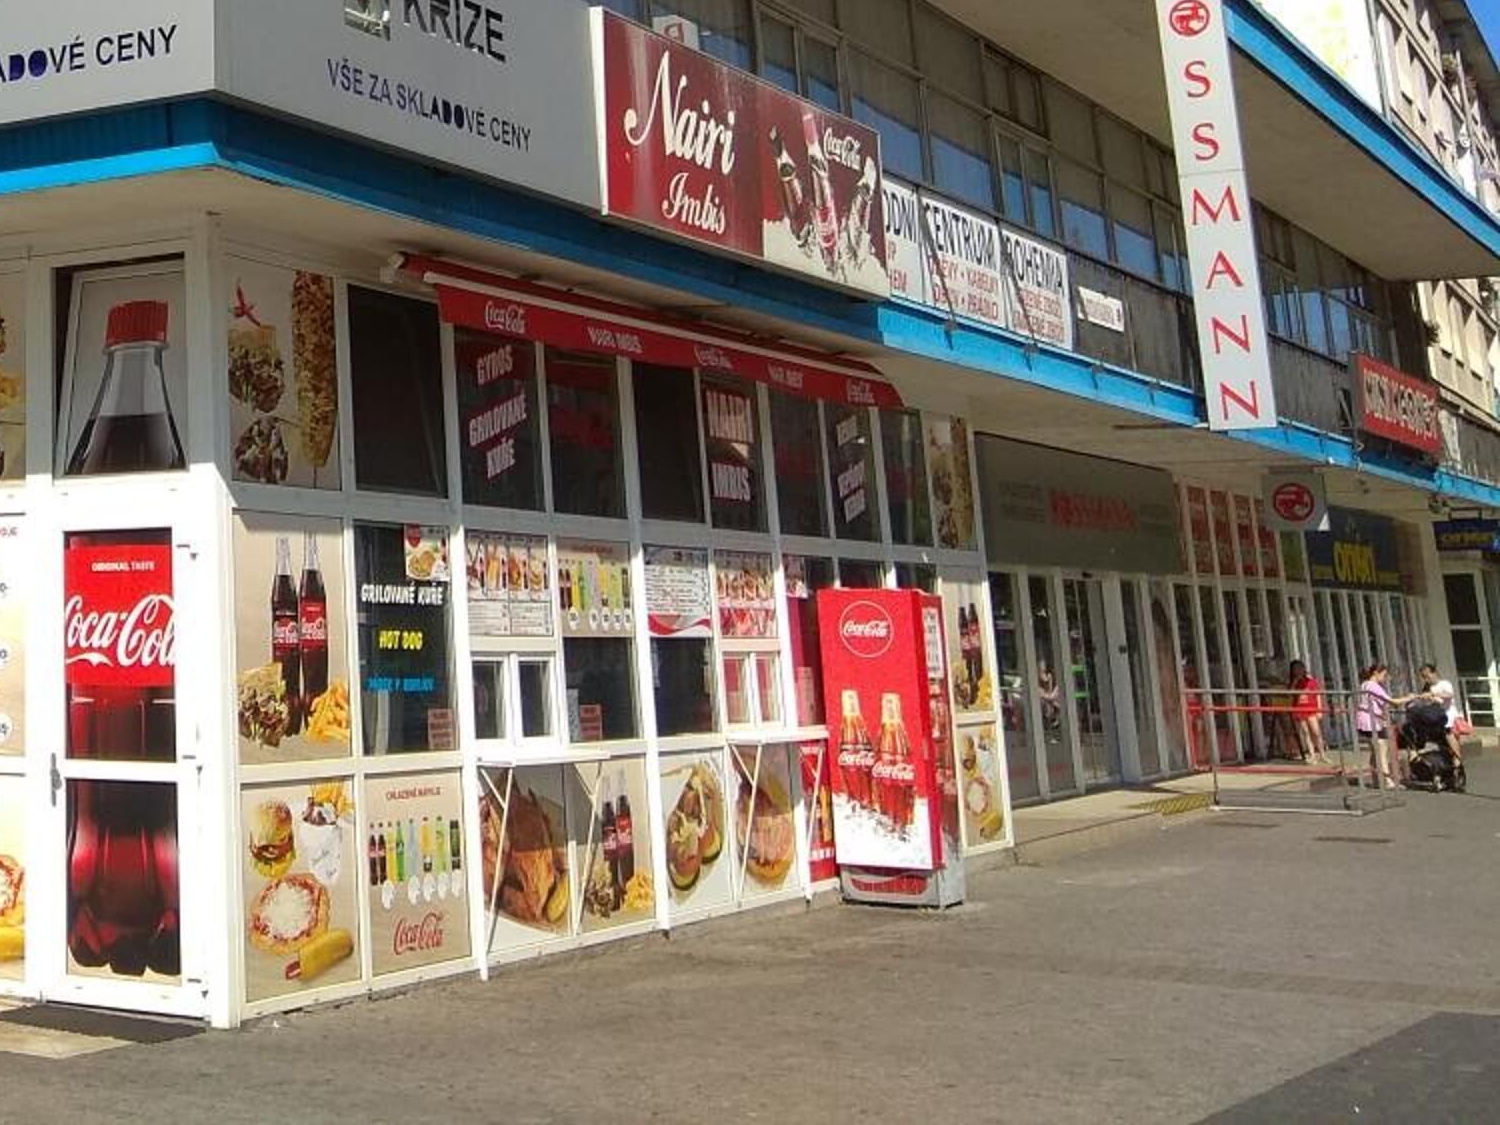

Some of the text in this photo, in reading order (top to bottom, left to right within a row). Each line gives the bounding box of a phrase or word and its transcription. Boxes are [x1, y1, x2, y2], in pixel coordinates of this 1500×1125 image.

[95, 23, 179, 67] CENY
[326, 57, 532, 153] VŠE ZA SKLADOVÉ CENY
[624, 48, 736, 176] Nairi
[661, 171, 727, 236] Imbis
[360, 582, 415, 605] GRILOVANÉ
[379, 630, 400, 650] HOT
[843, 619, 888, 637] Coca-Cola
[393, 911, 445, 956] Coca-Cola
